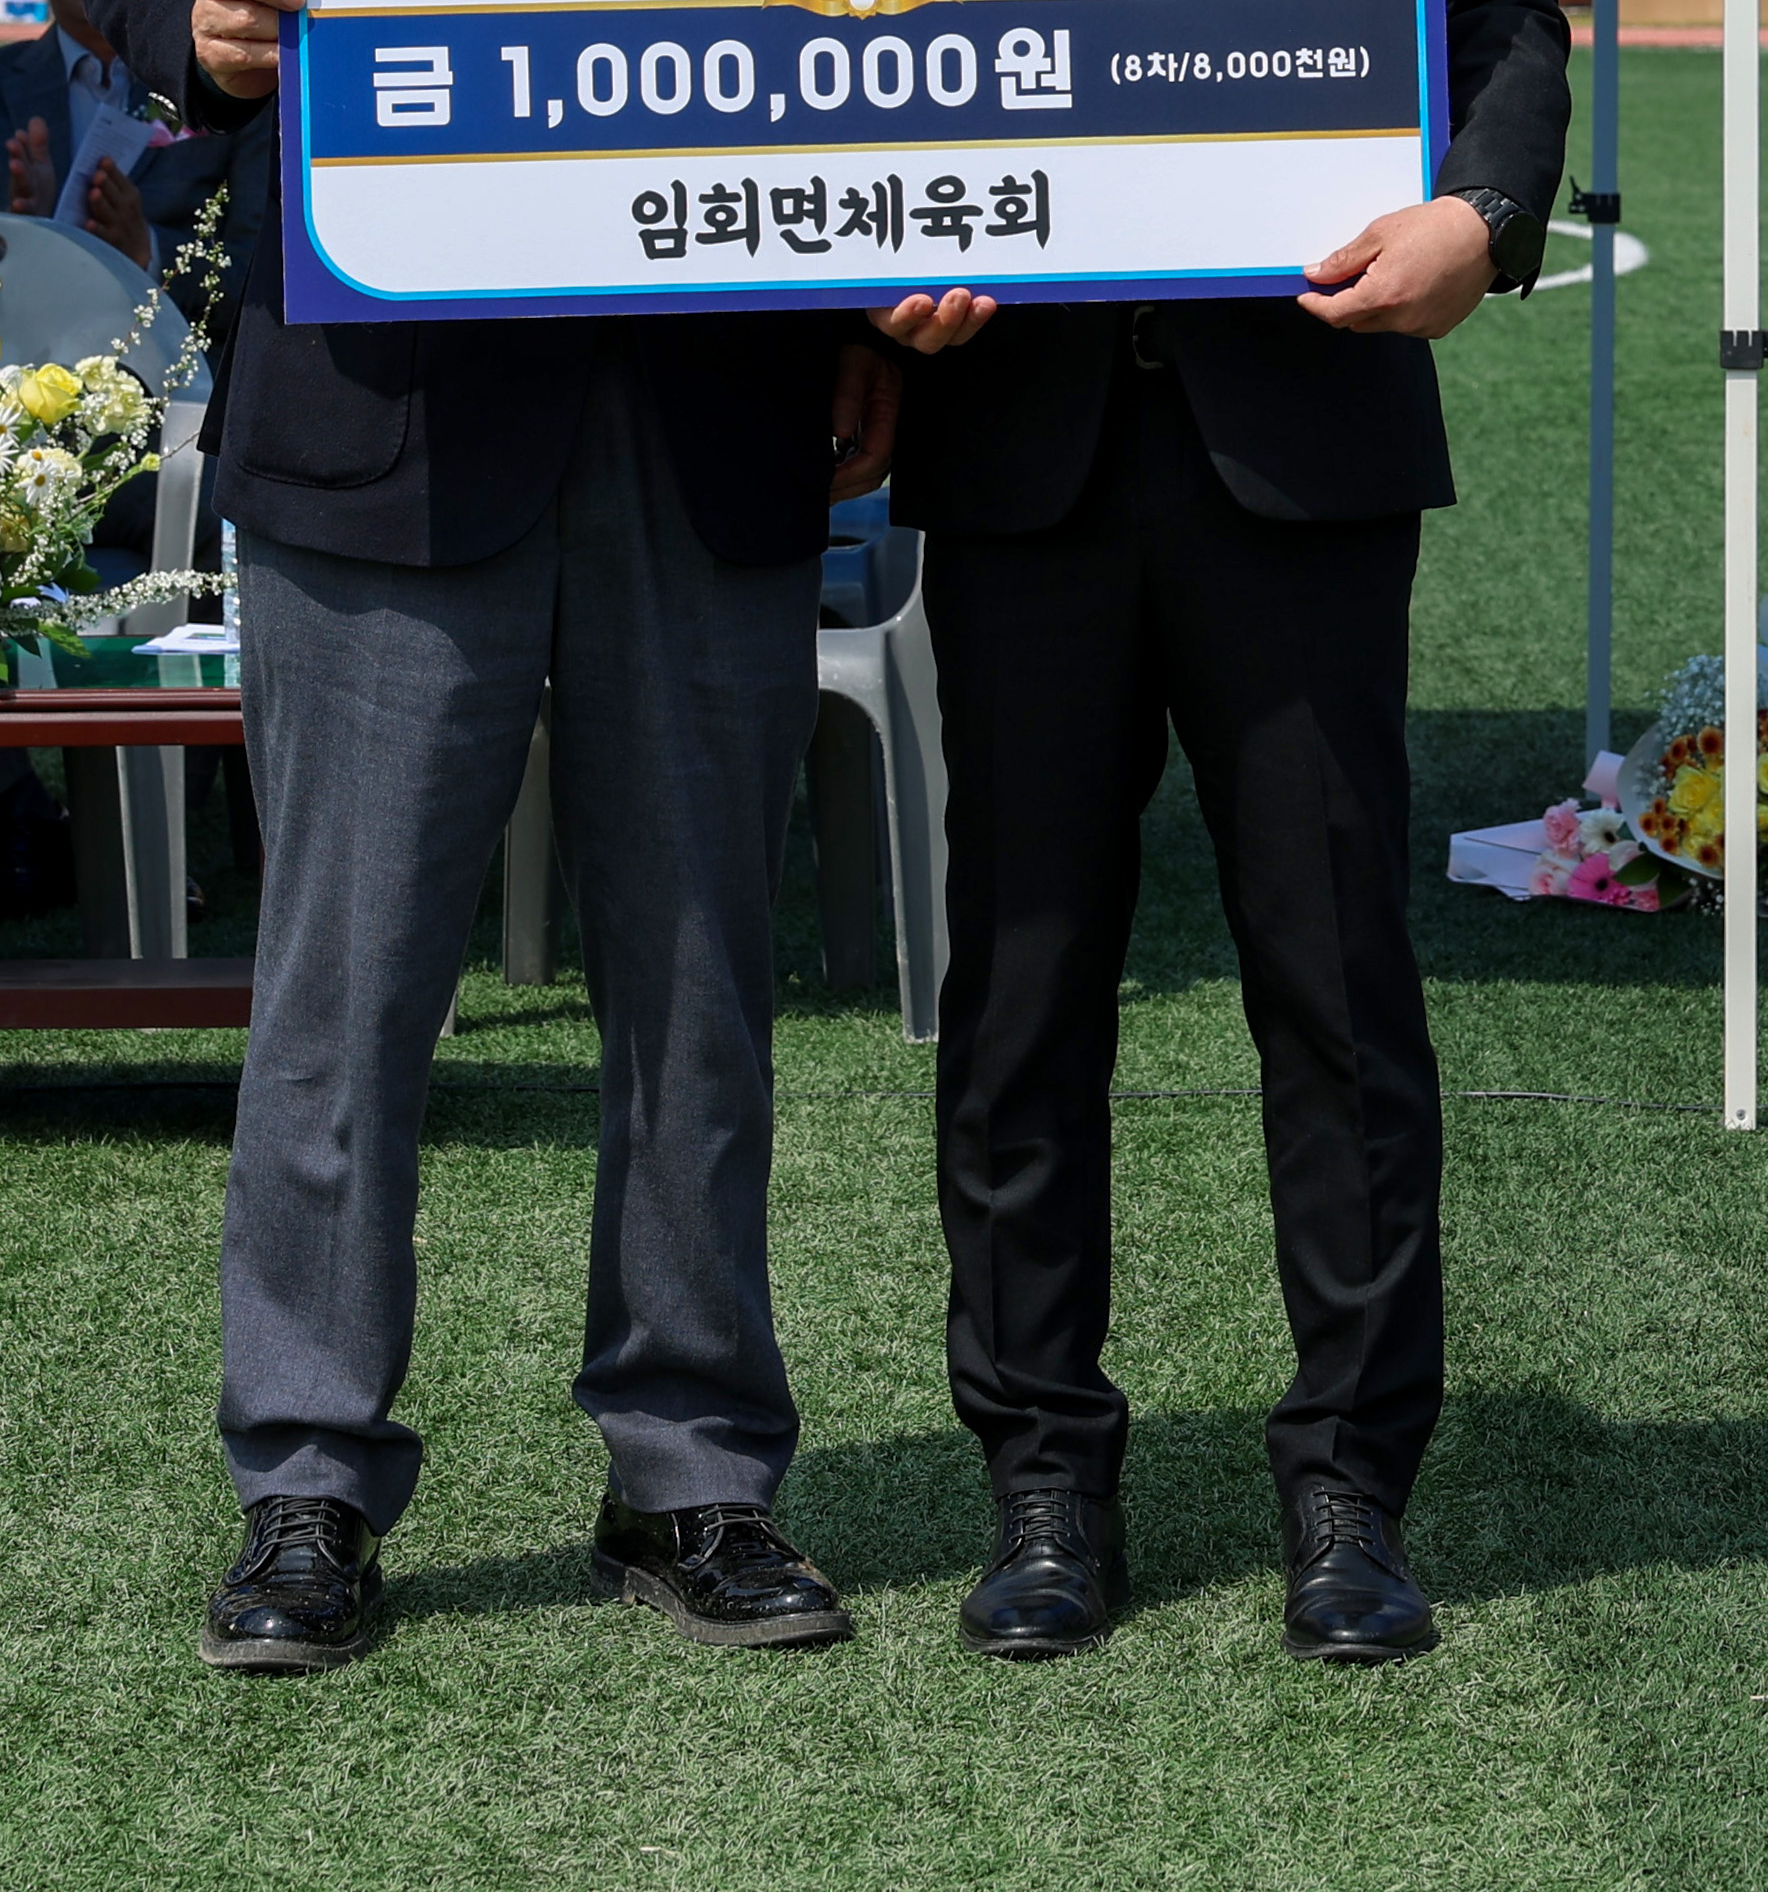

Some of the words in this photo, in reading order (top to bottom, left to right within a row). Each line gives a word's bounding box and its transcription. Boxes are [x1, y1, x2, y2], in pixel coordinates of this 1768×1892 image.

[373, 46, 454, 127] 금
[500, 26, 1073, 129] 1,000,000원
[1110, 46, 1371, 85] (8차/8,000천원)
[631, 169, 1051, 260] 임회면체육회
